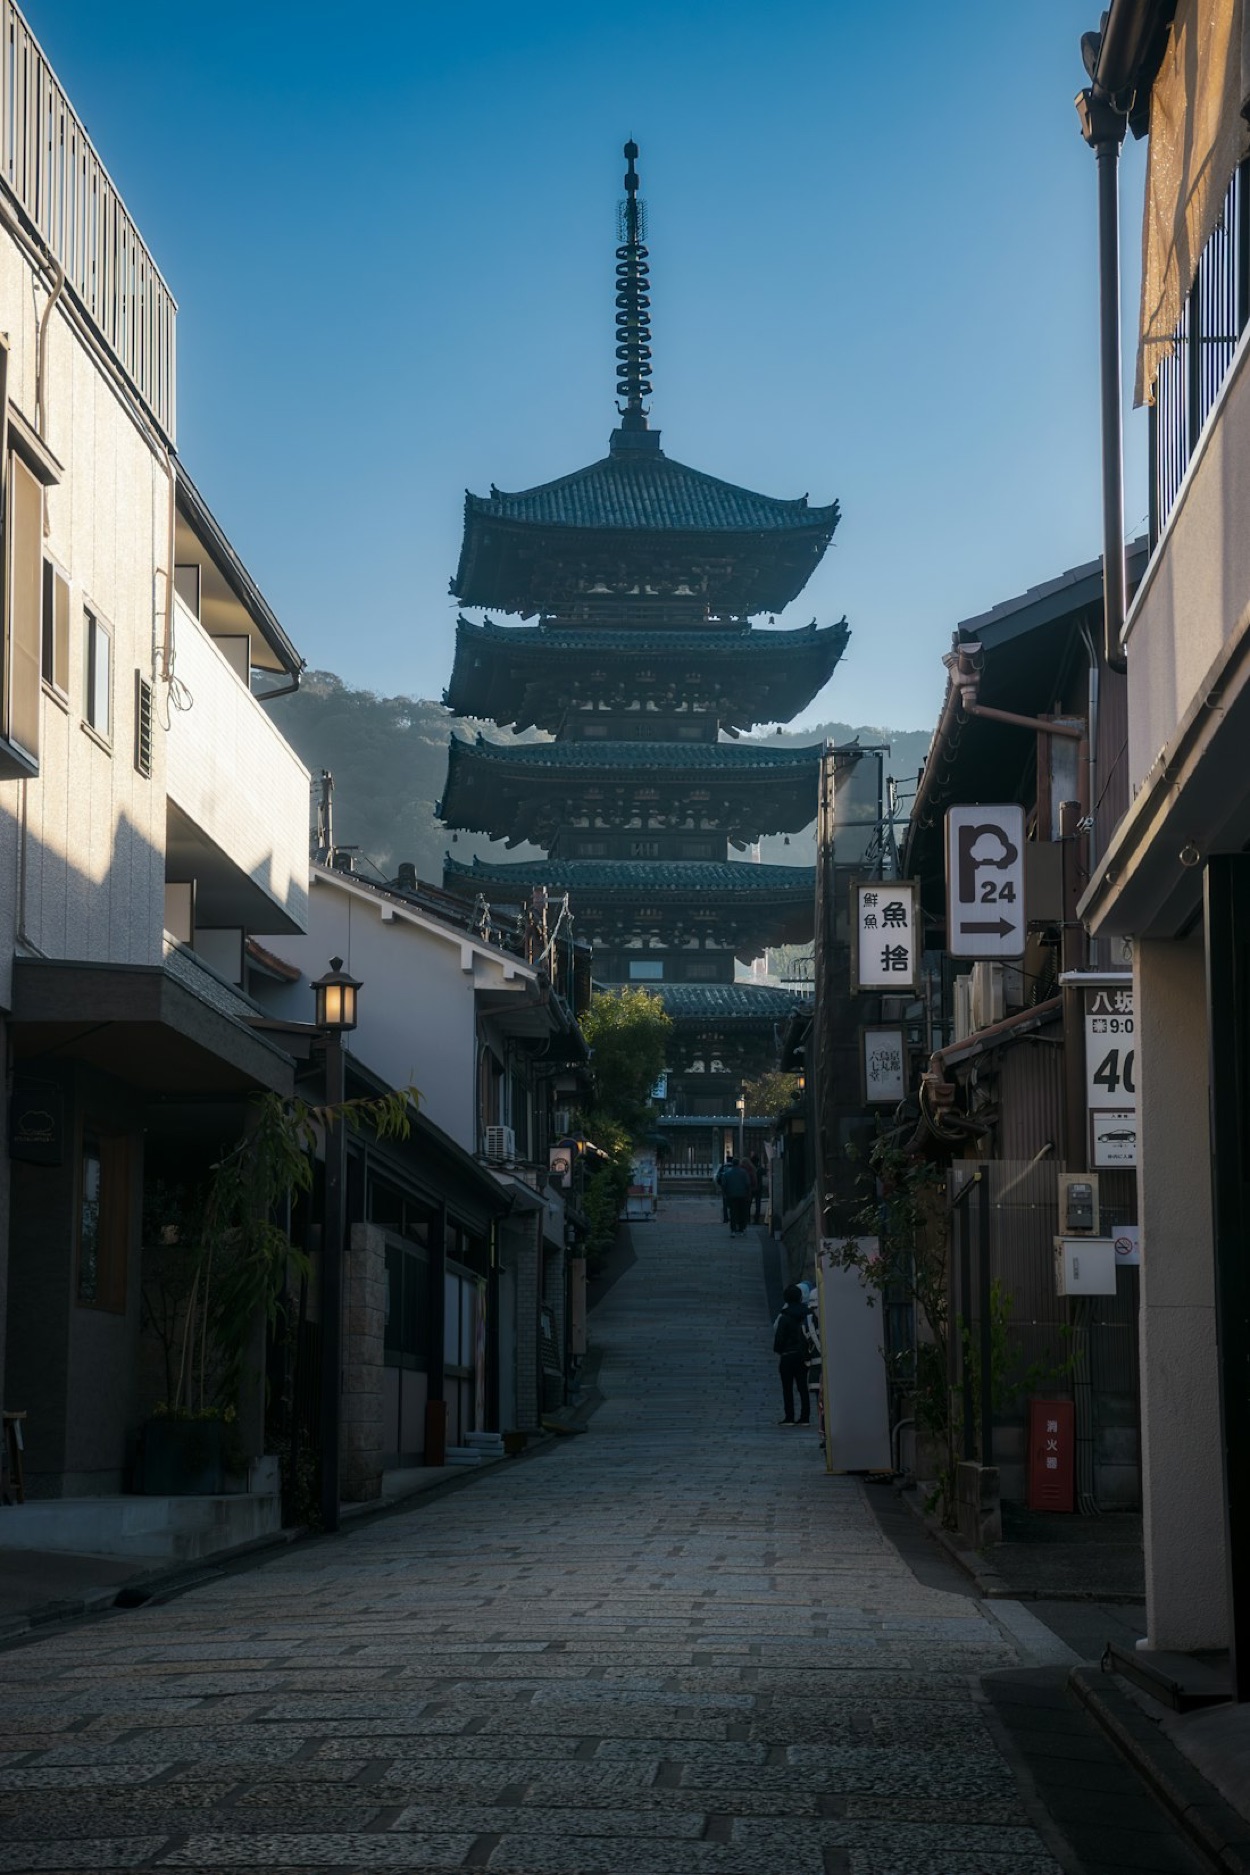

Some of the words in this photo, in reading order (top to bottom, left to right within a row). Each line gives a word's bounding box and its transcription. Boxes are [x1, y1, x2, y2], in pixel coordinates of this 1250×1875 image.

[863, 892, 878, 929] 鮮魚
[981, 881, 1016, 903] 24
[1047, 1420, 1058, 1469] 消火器
